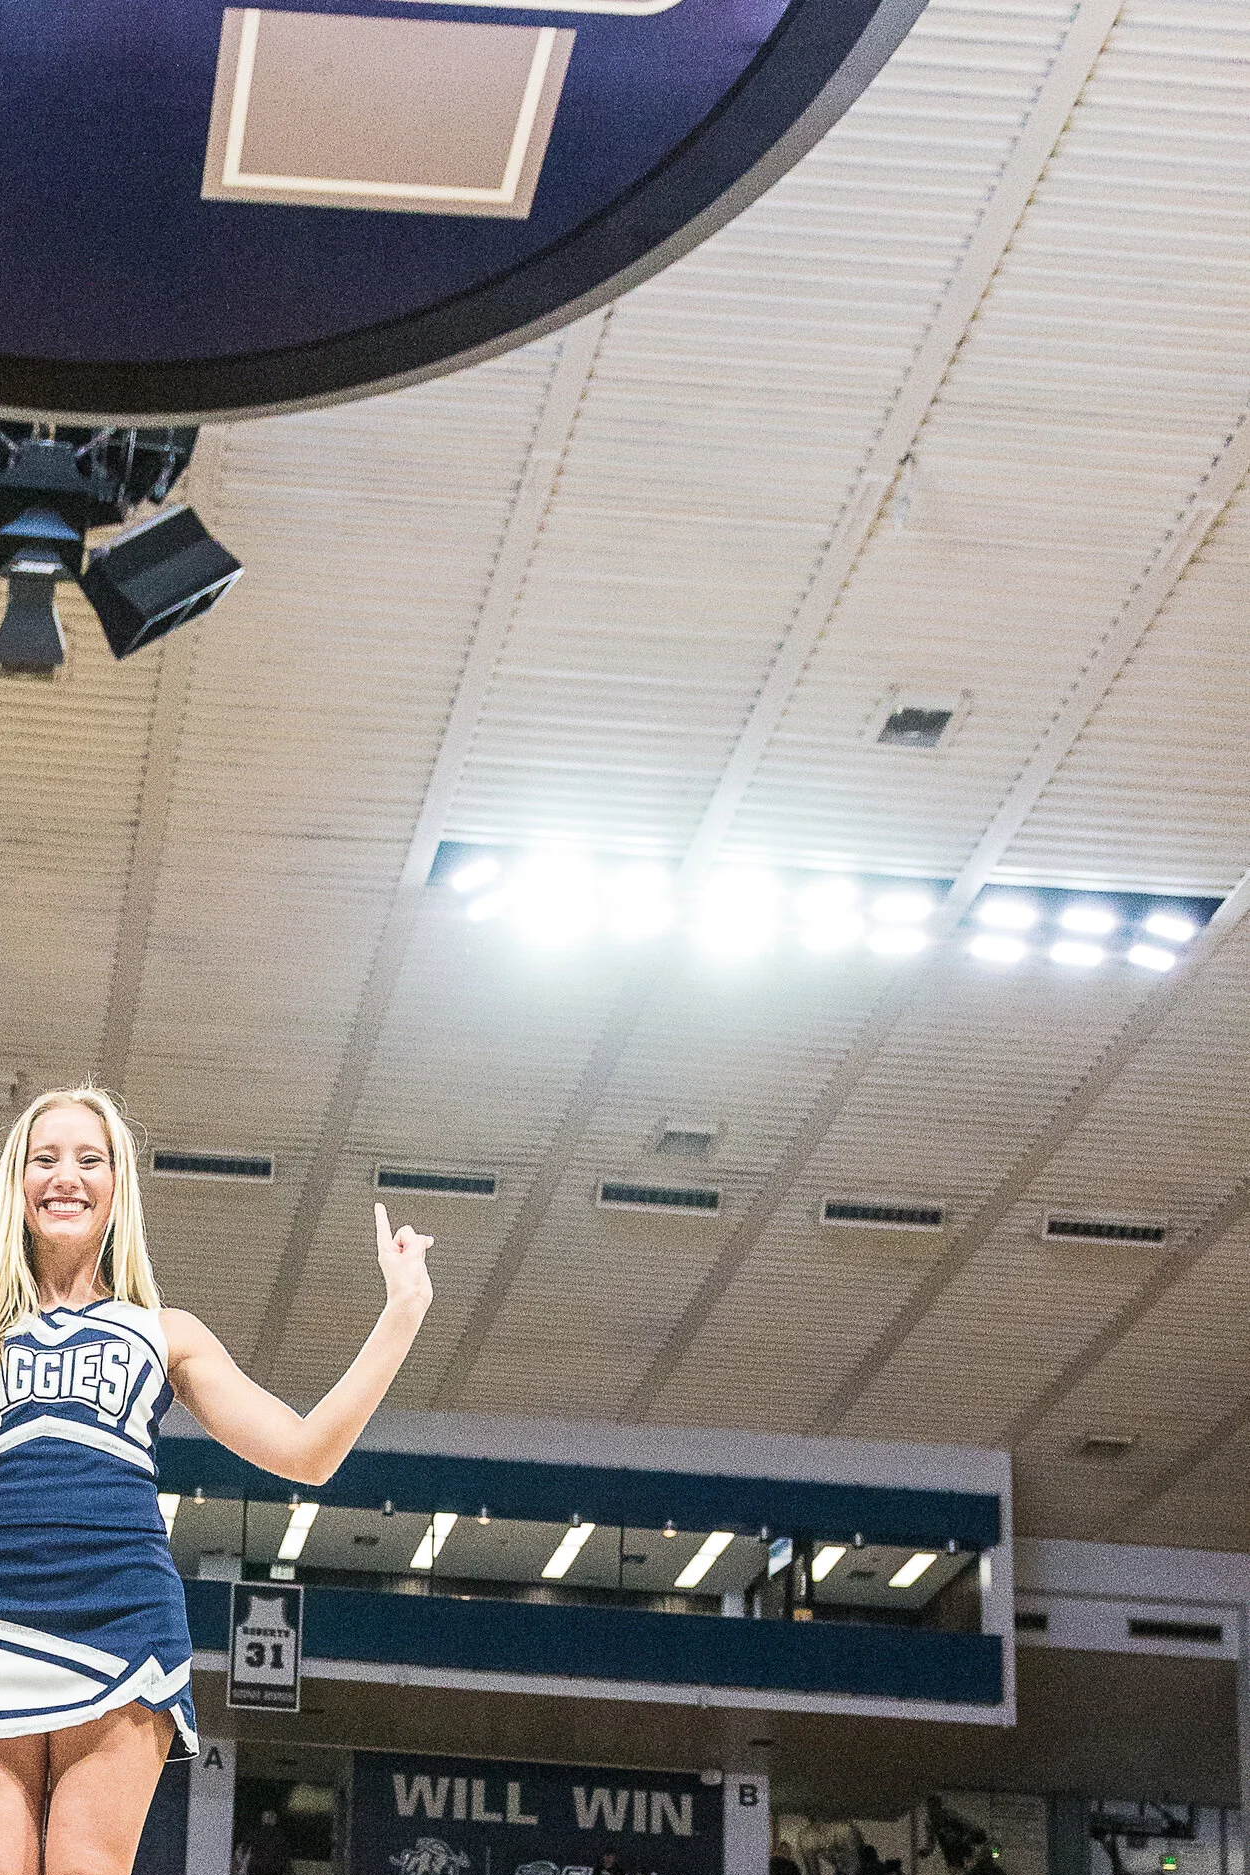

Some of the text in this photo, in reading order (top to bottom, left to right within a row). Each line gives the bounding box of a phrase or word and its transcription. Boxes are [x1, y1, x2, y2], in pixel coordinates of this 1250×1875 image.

[245, 1641, 284, 1670] 31
[203, 1746, 224, 1769] A
[392, 1772, 694, 1837] WILL WIN
[738, 1783, 759, 1807] B
